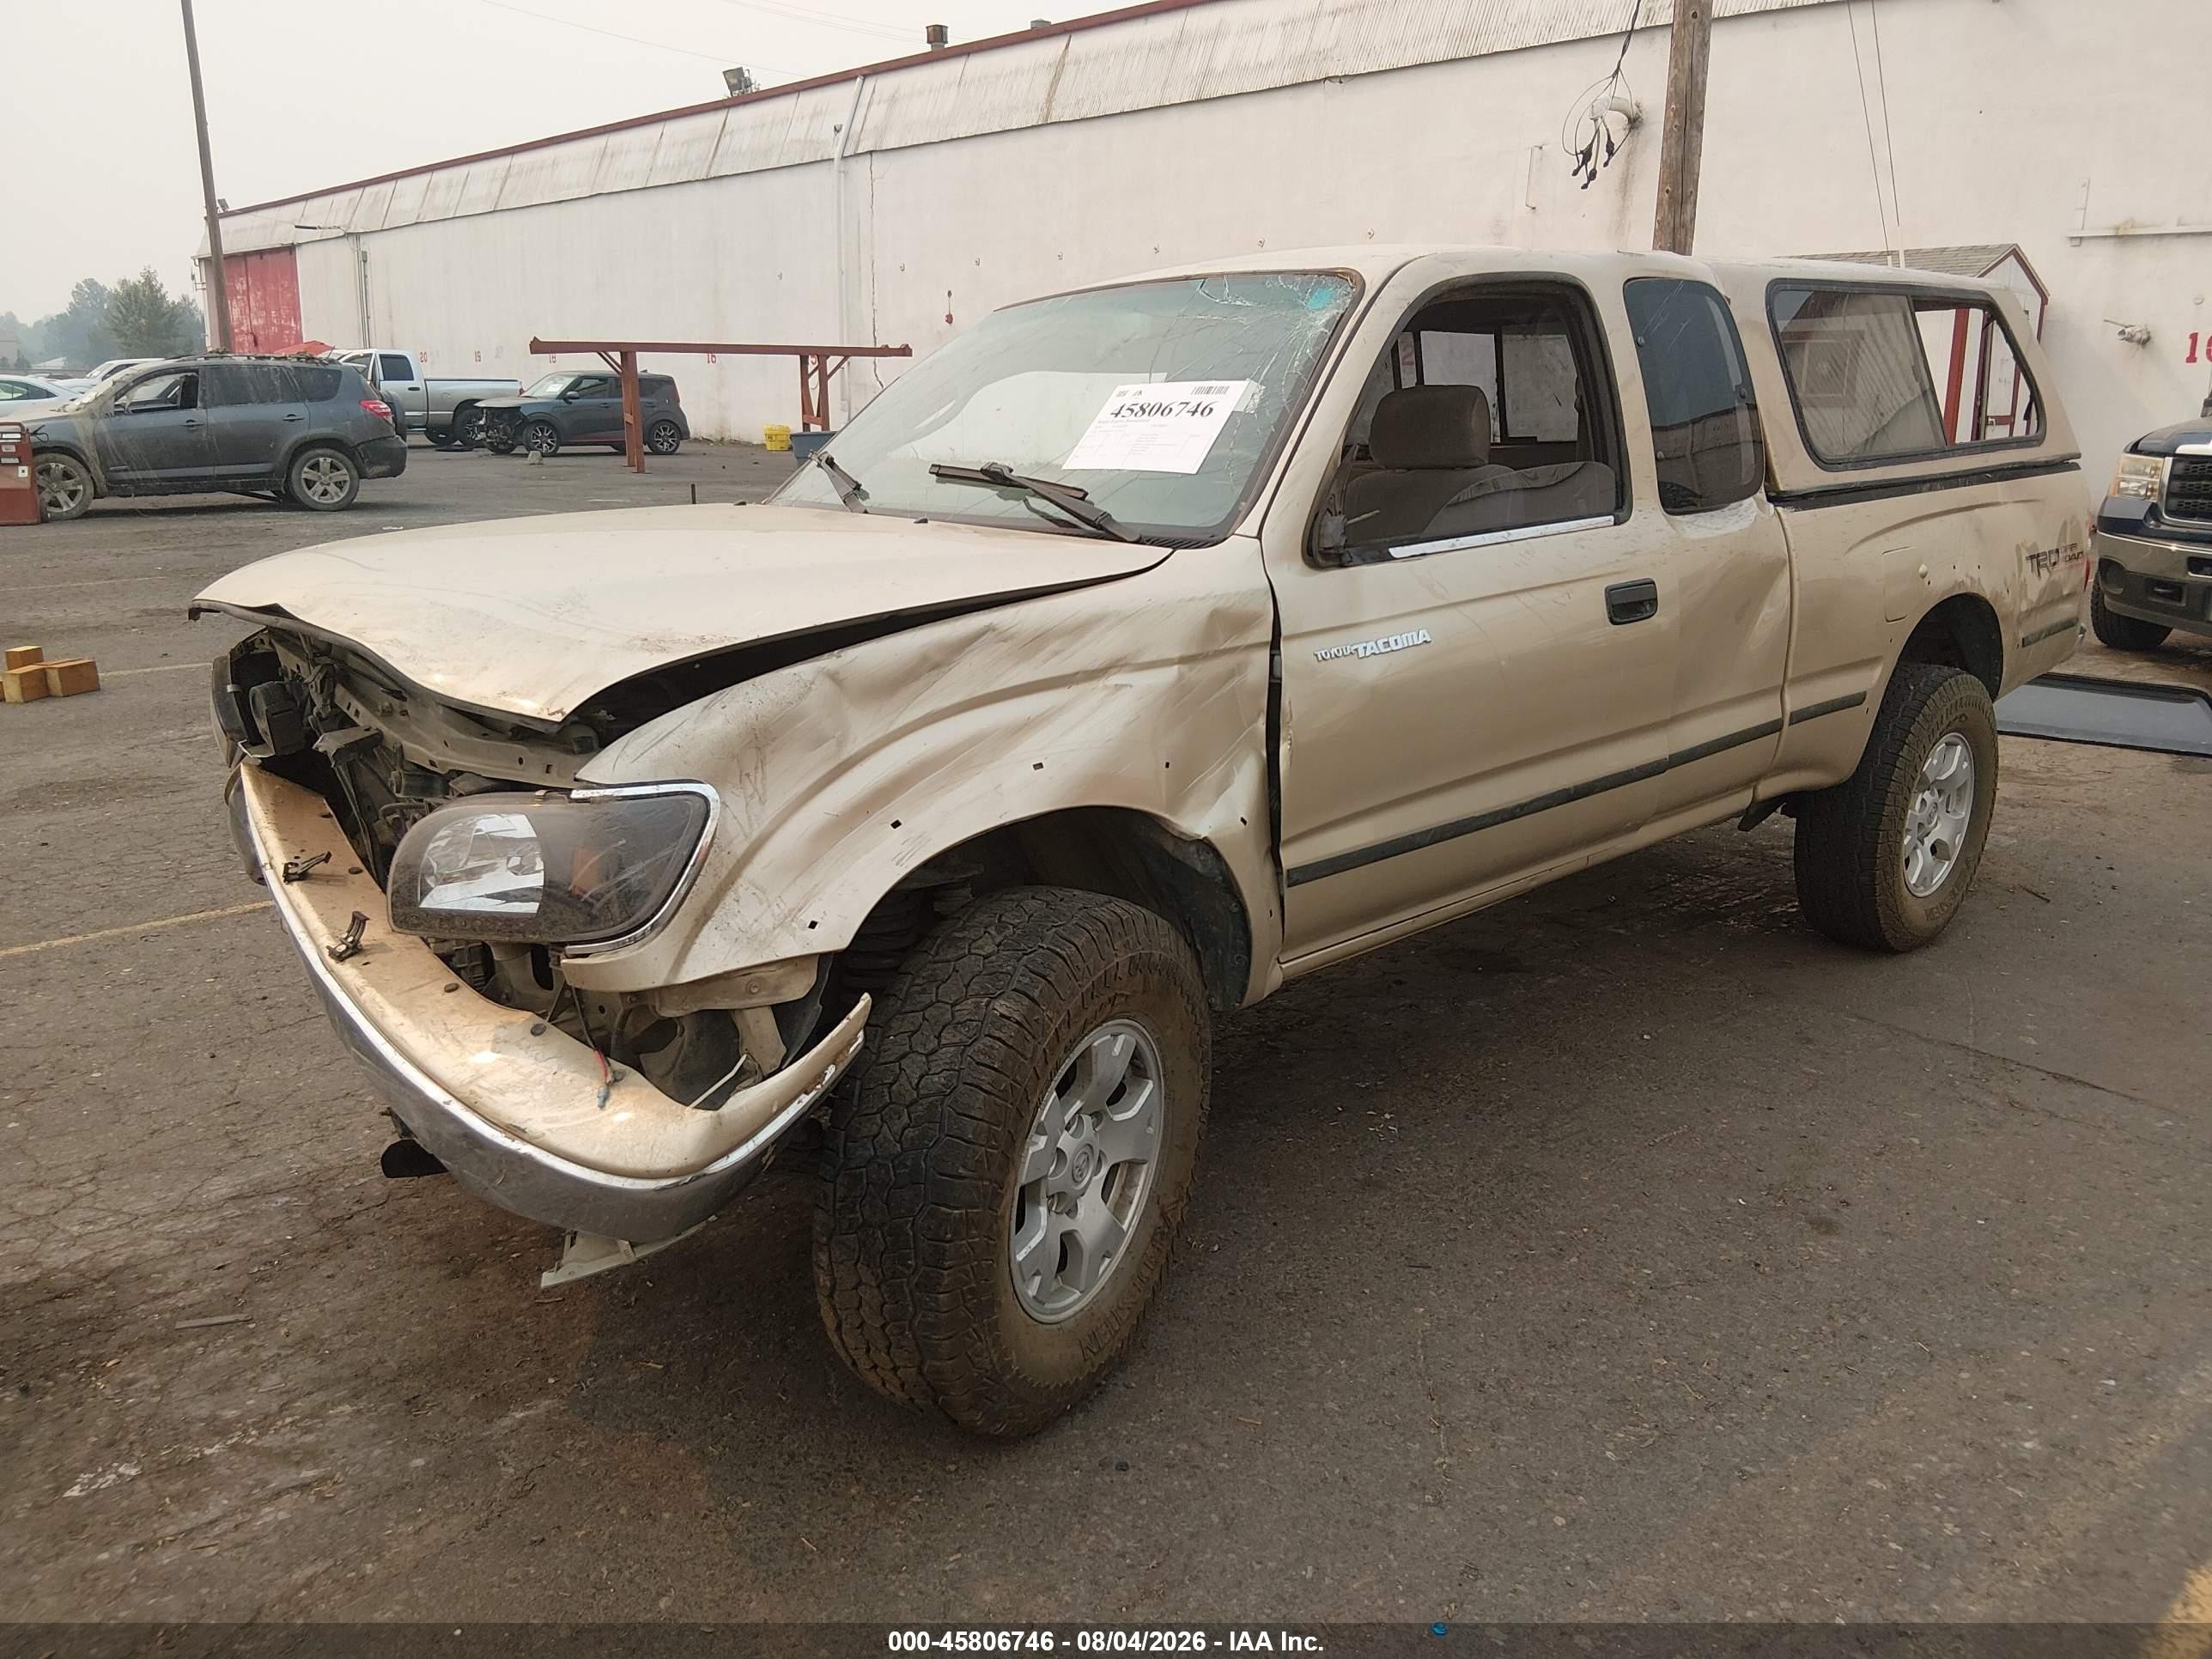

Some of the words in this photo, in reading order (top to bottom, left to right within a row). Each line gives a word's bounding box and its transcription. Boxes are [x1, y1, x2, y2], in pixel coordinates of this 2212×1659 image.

[420, 351, 428, 362] 20
[474, 350, 482, 362] 19
[1110, 400, 1218, 418] 45806746
[2026, 548, 2059, 576] TRD
[1315, 645, 1354, 661] TOYOTA
[1353, 629, 1431, 659] TACOMA
